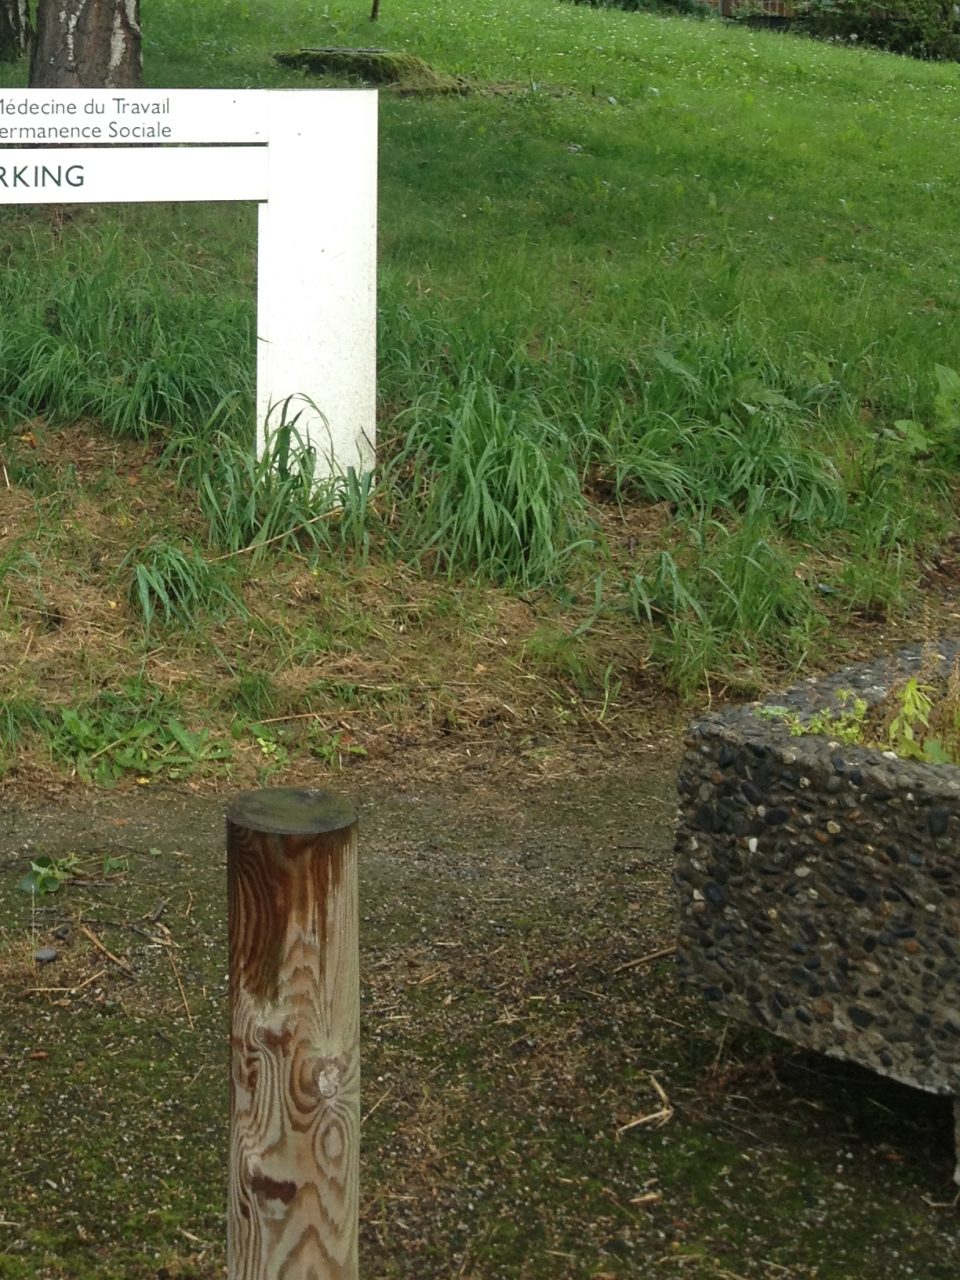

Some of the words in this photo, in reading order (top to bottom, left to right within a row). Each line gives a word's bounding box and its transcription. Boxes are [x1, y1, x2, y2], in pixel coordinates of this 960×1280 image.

[83, 98, 106, 115] du
[112, 97, 171, 115] Travail
[108, 122, 172, 138] Sociale
